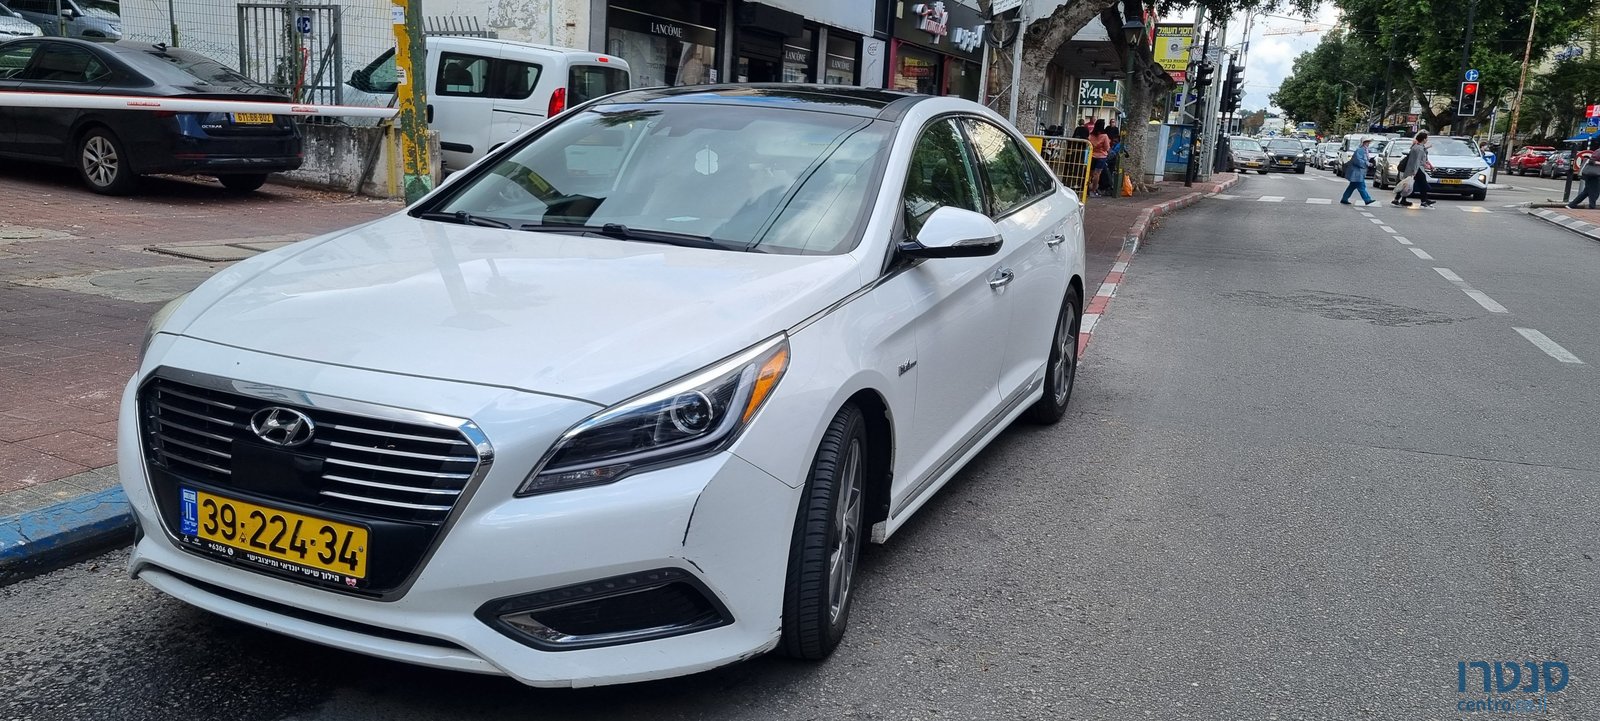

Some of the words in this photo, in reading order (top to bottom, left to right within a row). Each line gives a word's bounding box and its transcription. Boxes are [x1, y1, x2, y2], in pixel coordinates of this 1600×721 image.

[651, 22, 683, 38] LANCÔME
[785, 50, 806, 63] LANCÔME
[831, 59, 850, 71] LANCÔME
[185, 502, 195, 521] IL
[279, 562, 300, 572] יונדאי
[301, 567, 320, 577] שישי
[320, 571, 340, 582] הילוך
